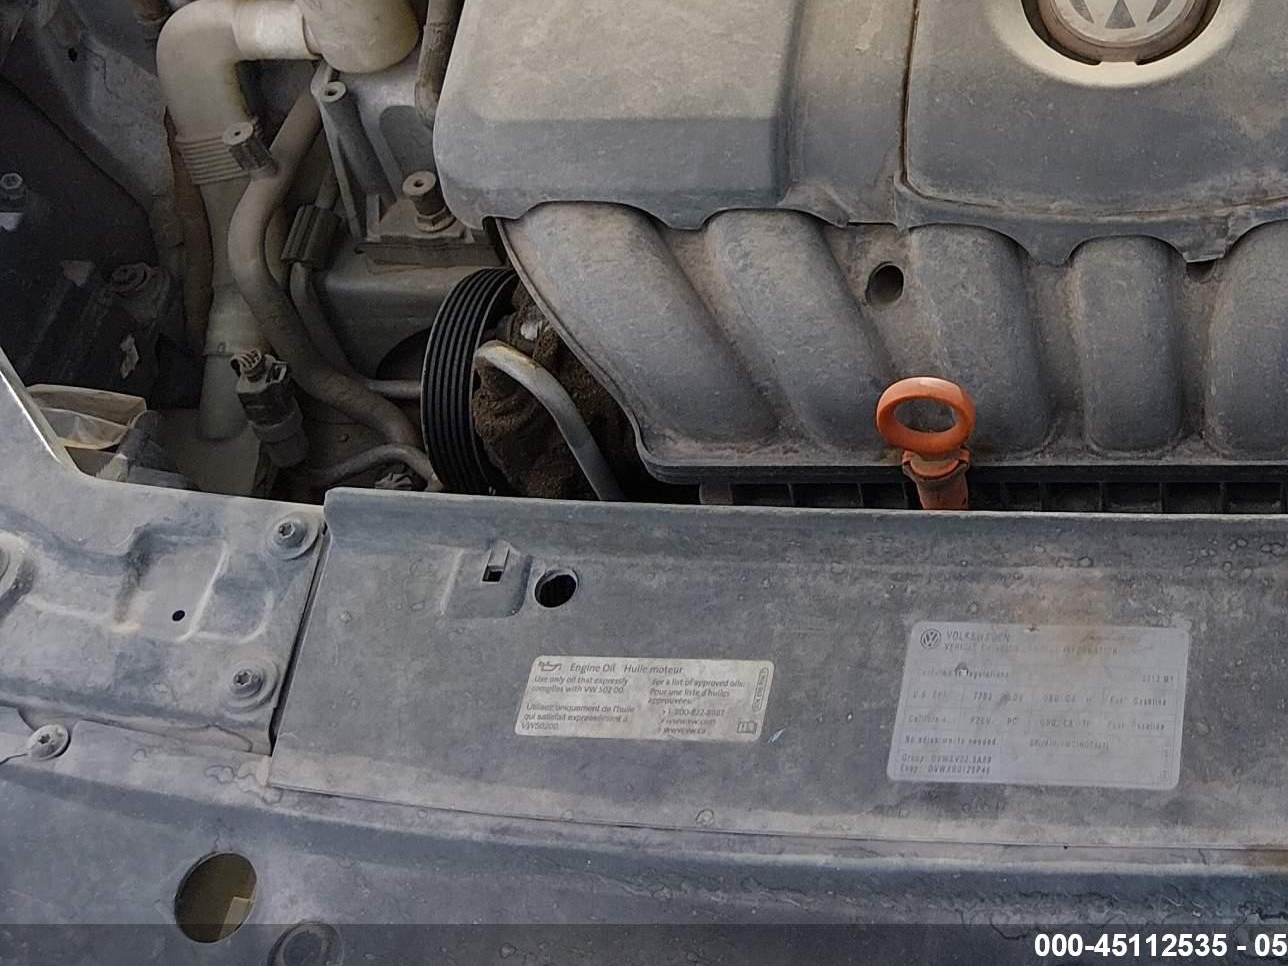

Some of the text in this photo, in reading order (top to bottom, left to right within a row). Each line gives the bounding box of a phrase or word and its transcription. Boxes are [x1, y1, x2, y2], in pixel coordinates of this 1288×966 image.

[569, 662, 684, 674] Engine Oil Huile moteur
[534, 675, 549, 683] Use
[549, 676, 565, 685] only
[566, 675, 577, 683] oil
[577, 675, 593, 684] that
[652, 678, 664, 686] For
[671, 678, 683, 686] list
[685, 678, 694, 687] of
[694, 679, 729, 688] approved
[531, 685, 564, 694] complies
[565, 685, 582, 693] with
[613, 686, 624, 694] 00
[649, 687, 667, 695] Pour
